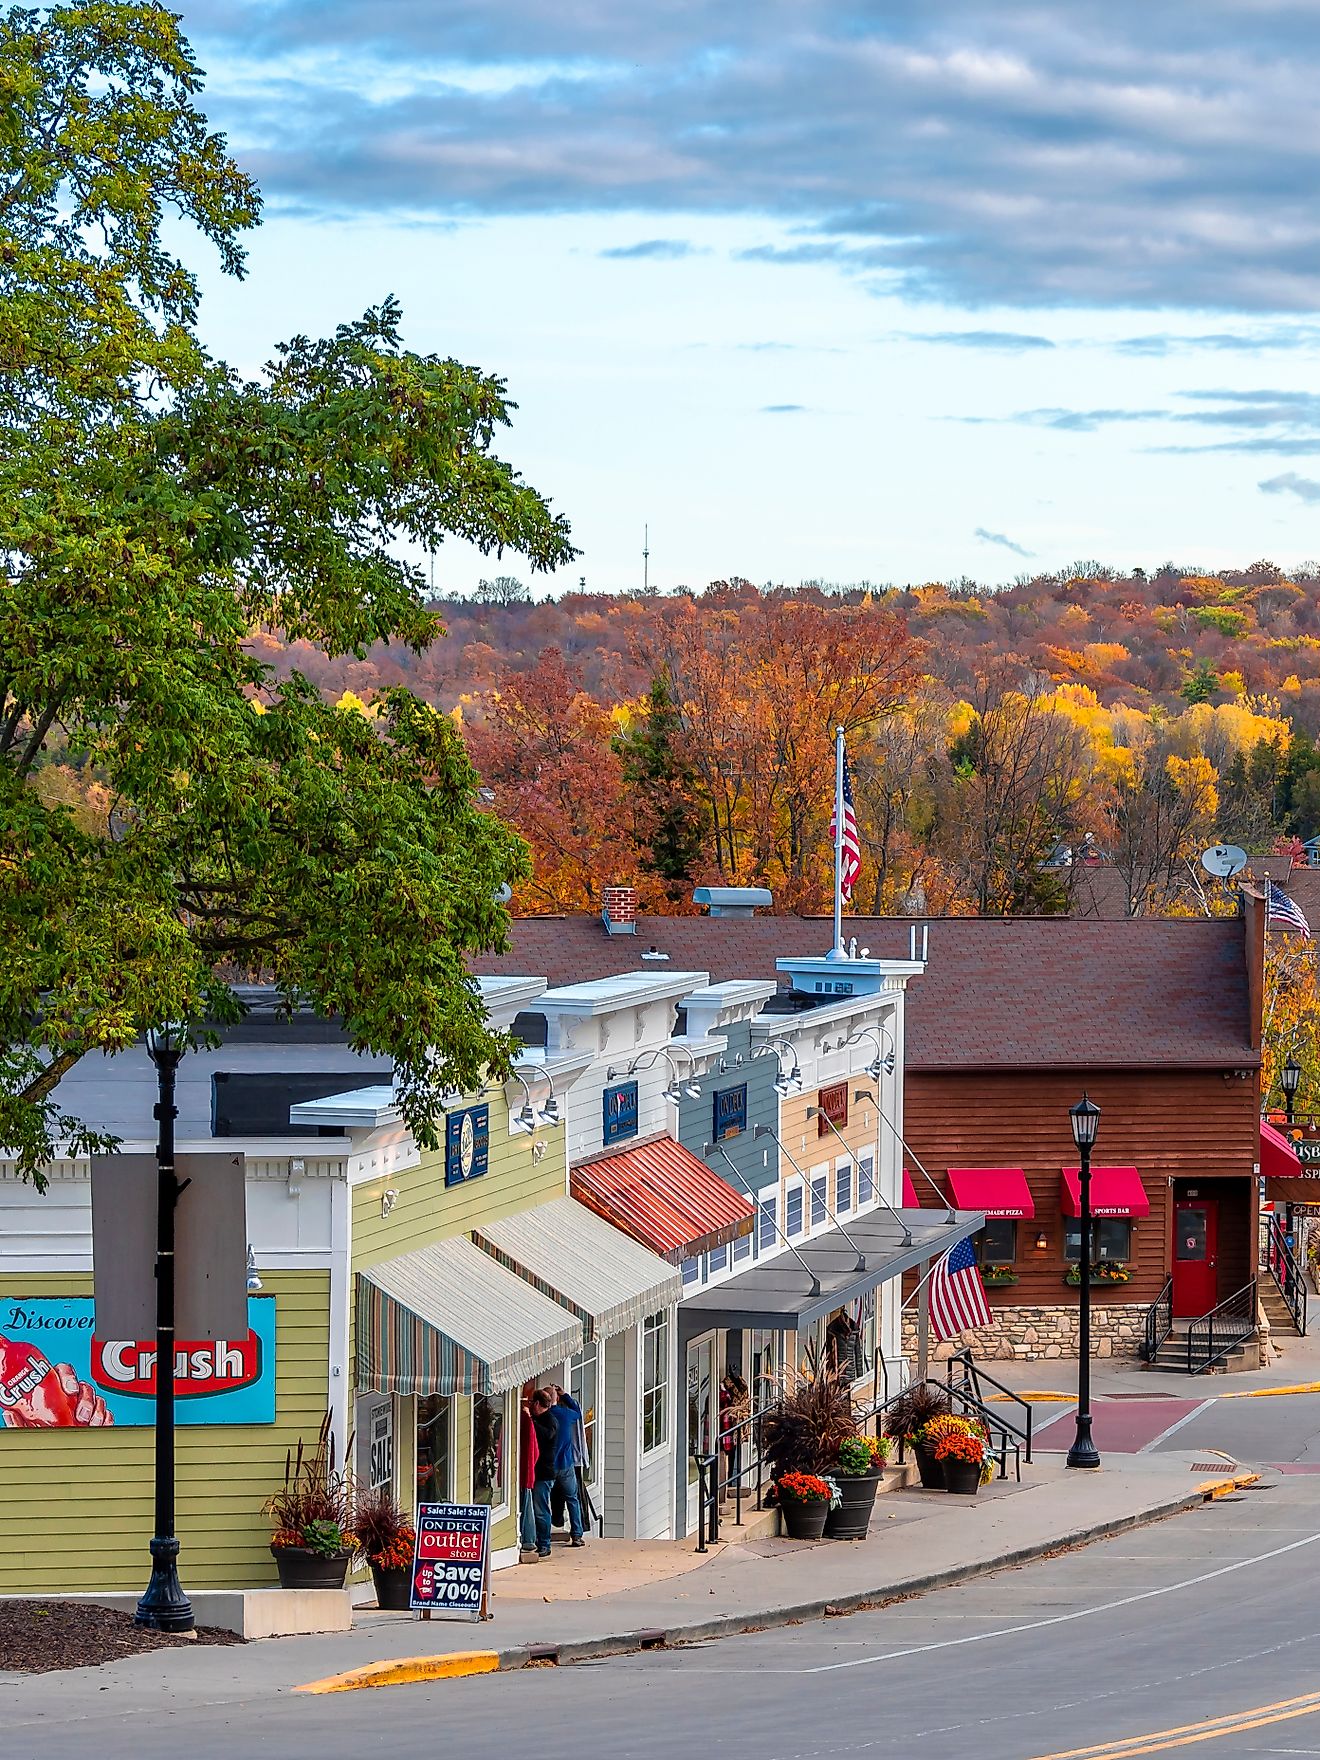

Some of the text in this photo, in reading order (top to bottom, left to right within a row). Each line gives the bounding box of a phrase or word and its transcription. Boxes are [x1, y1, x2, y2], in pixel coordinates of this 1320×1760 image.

[1293, 1205, 1320, 1216] OPEN
[3, 1307, 95, 1329] Discover
[7, 1367, 30, 1386] ORANGE
[371, 1436, 392, 1486] SALE
[427, 1506, 487, 1517] Sale! Sale! Sale!
[424, 1520, 480, 1531] ON DECK
[423, 1532, 479, 1548] outlet
[449, 1550, 478, 1558] store
[422, 1569, 433, 1578] Up
[433, 1562, 482, 1581] Save
[435, 1583, 479, 1600] 70%
